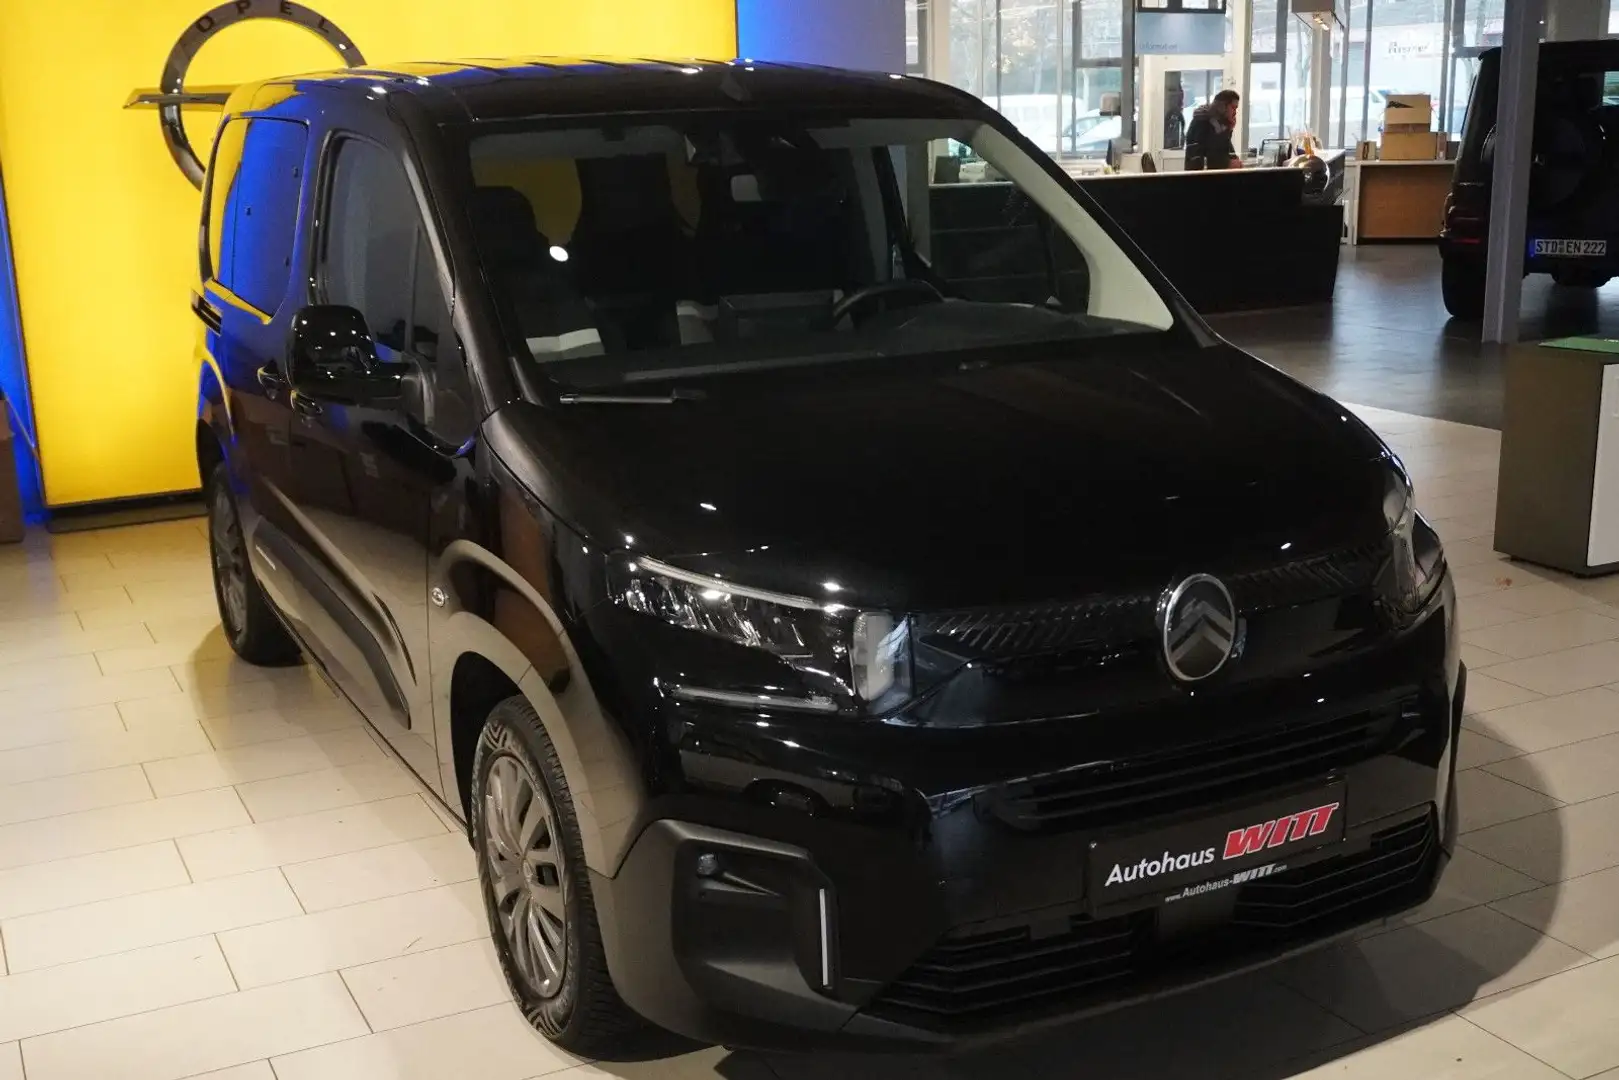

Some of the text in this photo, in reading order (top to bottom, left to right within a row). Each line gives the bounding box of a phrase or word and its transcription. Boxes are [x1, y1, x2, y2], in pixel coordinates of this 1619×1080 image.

[195, 0, 330, 33] OPEL
[1535, 241, 1605, 254] STD EN 222
[1104, 802, 1340, 887] Autohaus WITT
